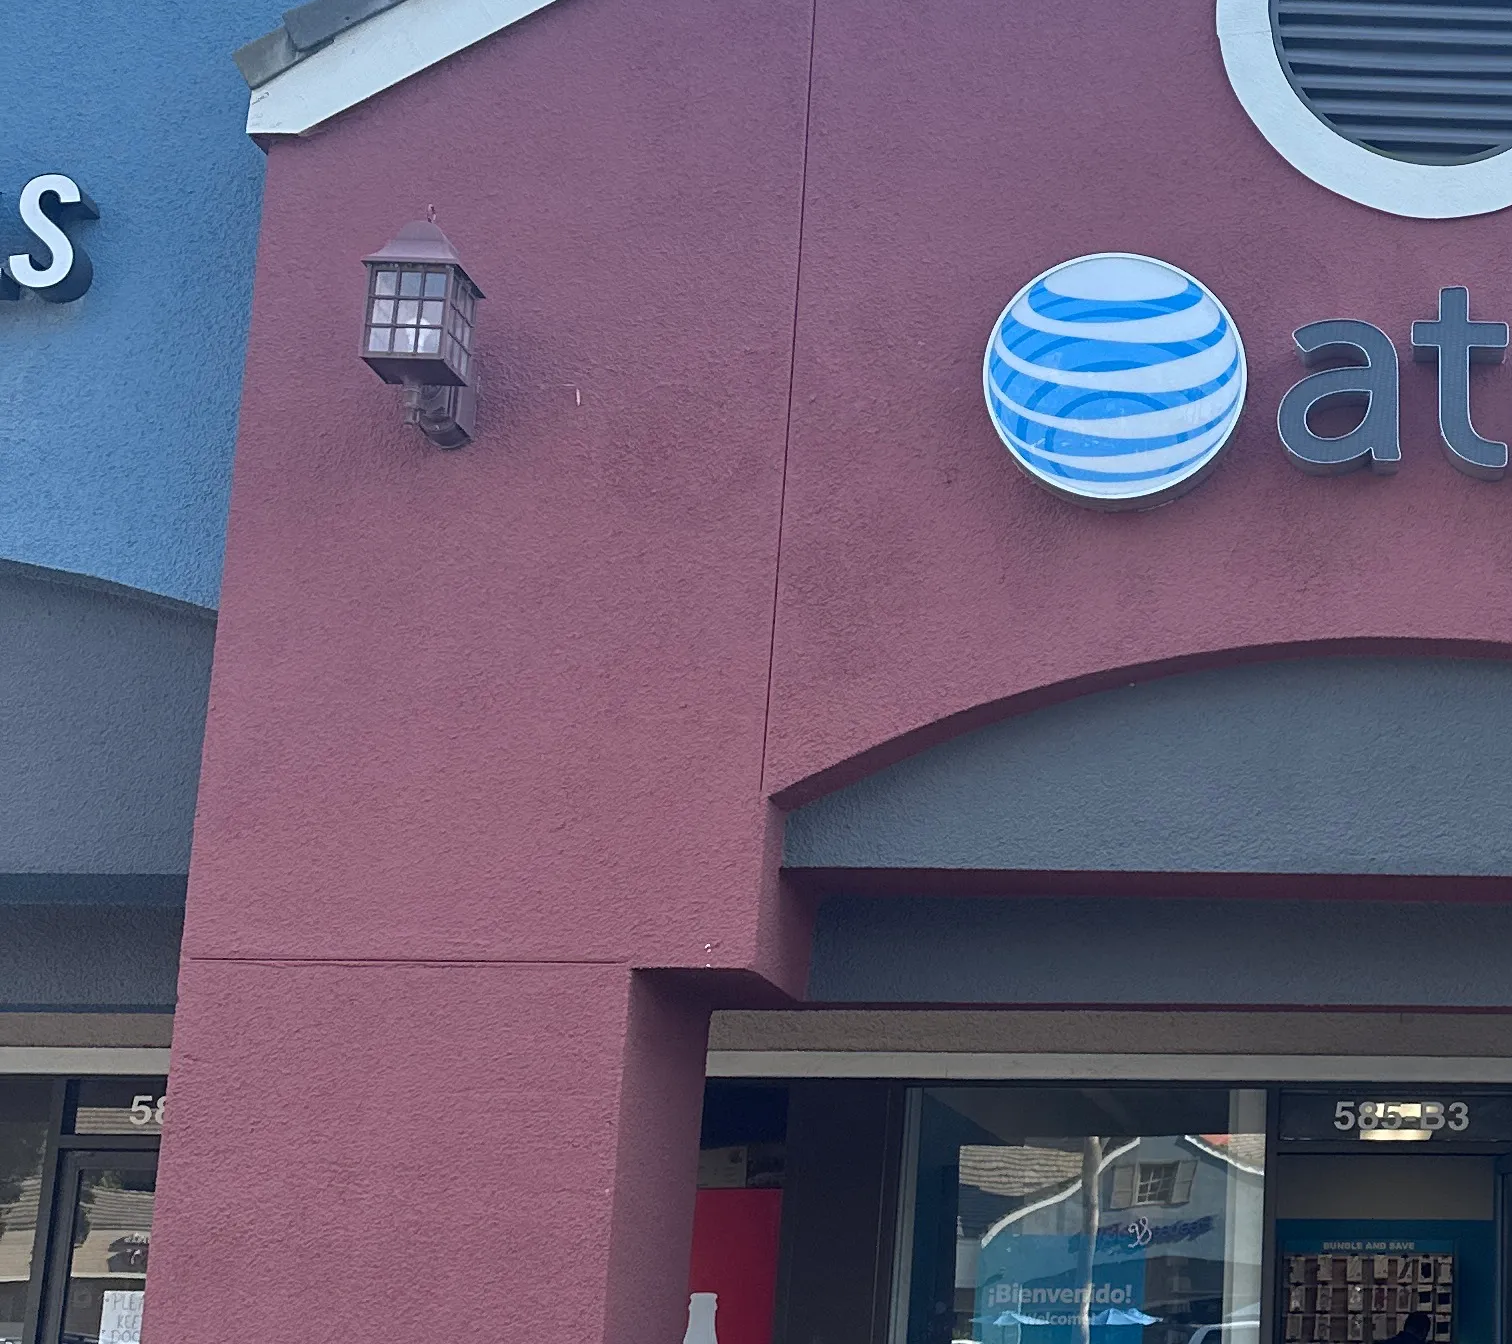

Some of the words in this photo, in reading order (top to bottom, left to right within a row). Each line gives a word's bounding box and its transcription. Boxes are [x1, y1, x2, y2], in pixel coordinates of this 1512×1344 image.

[129, 1095, 166, 1125] 58
[1333, 1100, 1470, 1131] 585-B3
[1322, 1241, 1363, 1250] BUNDLE
[1365, 1241, 1387, 1250] AND
[1388, 1241, 1416, 1250] SAVE
[117, 1314, 141, 1329] KEE
[111, 1329, 139, 1344] DOO
